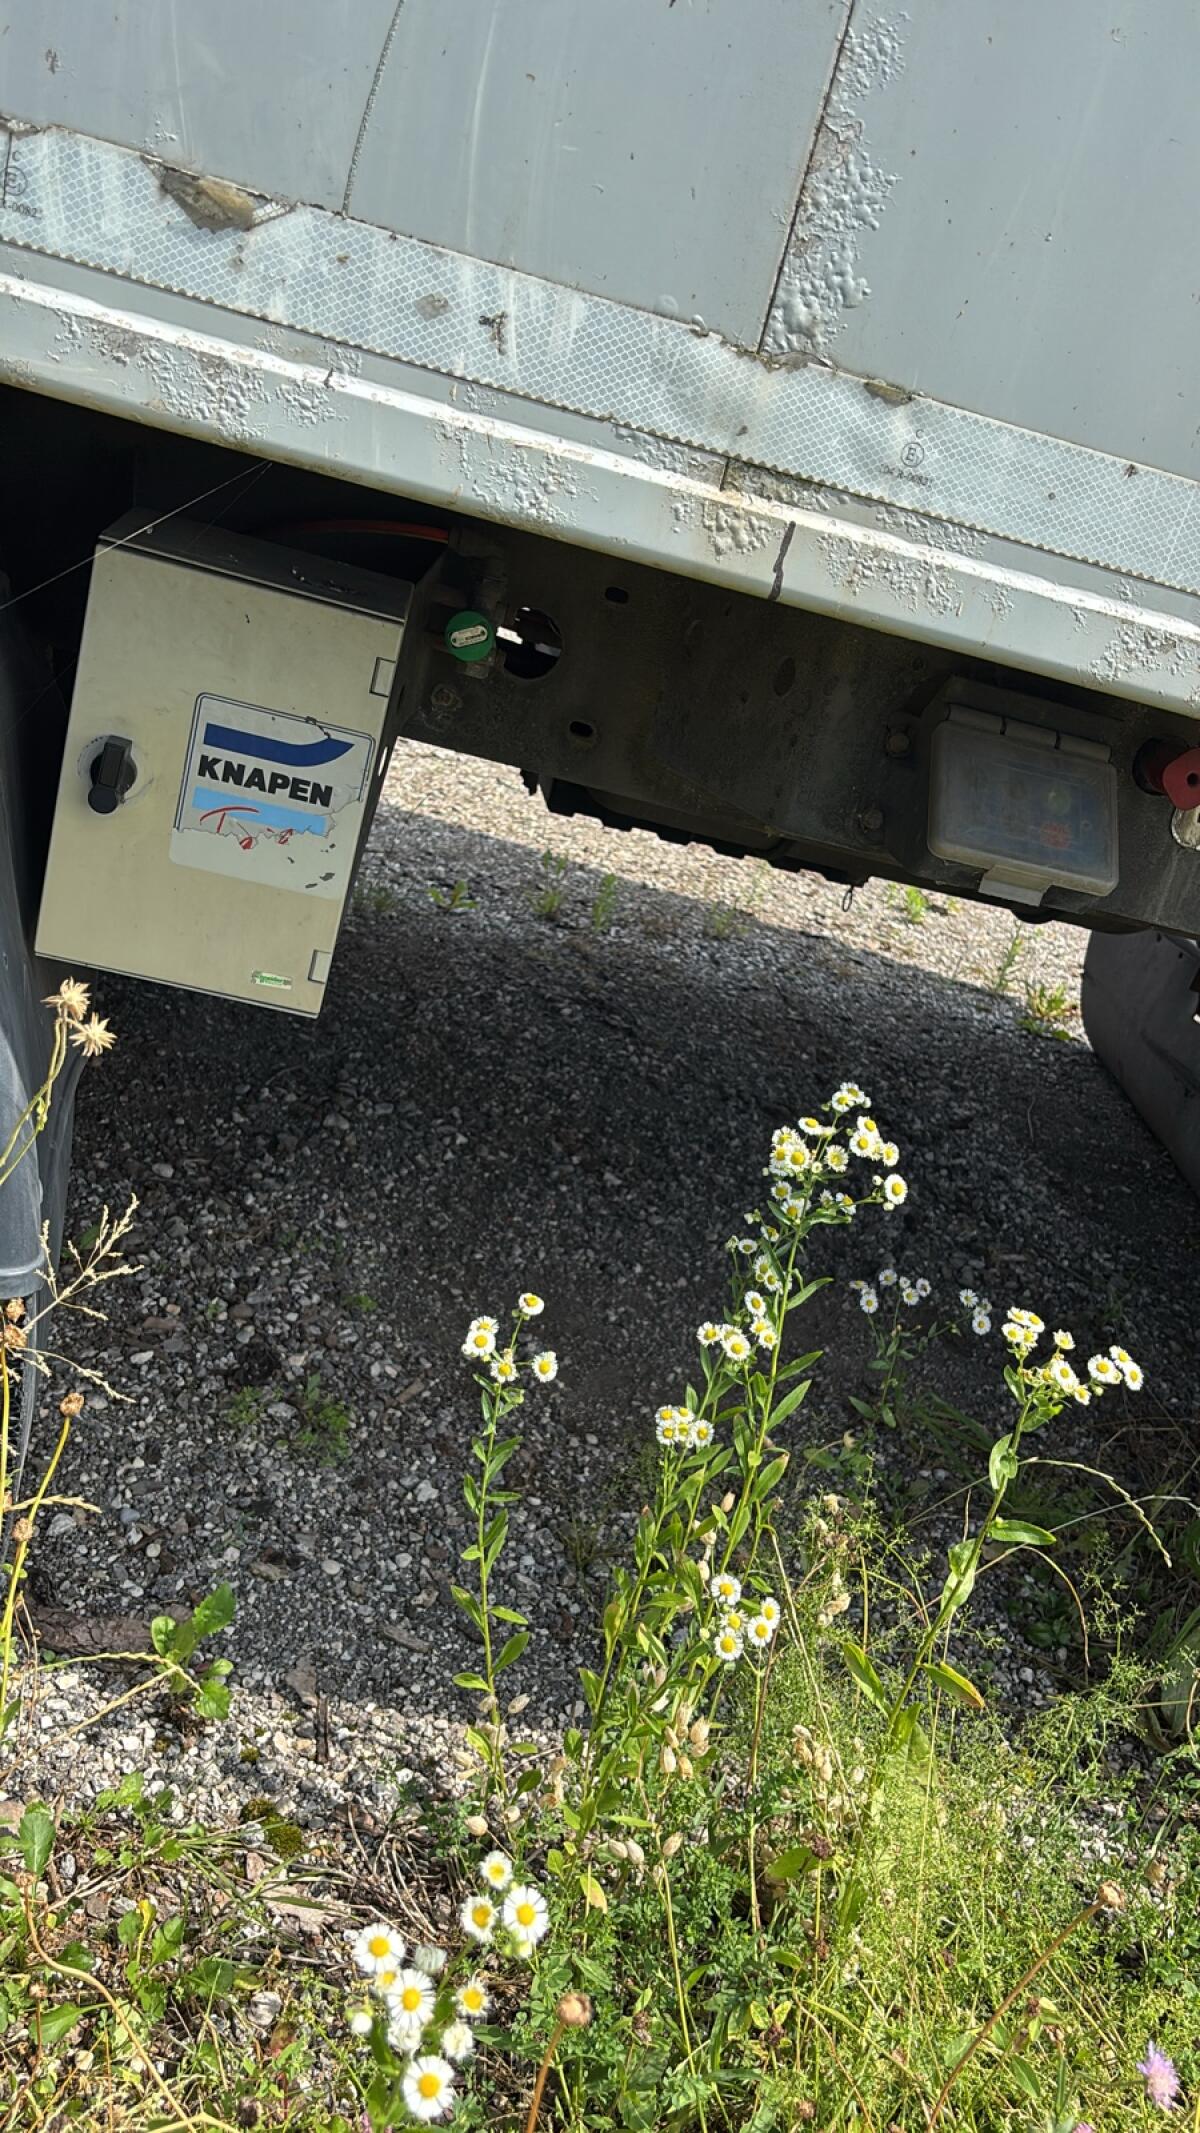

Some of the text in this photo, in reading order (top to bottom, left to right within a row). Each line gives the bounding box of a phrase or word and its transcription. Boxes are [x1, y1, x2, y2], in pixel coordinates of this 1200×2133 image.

[11, 150, 21, 162] C
[915, 428, 925, 439] C
[197, 754, 333, 808] KNAPEN
